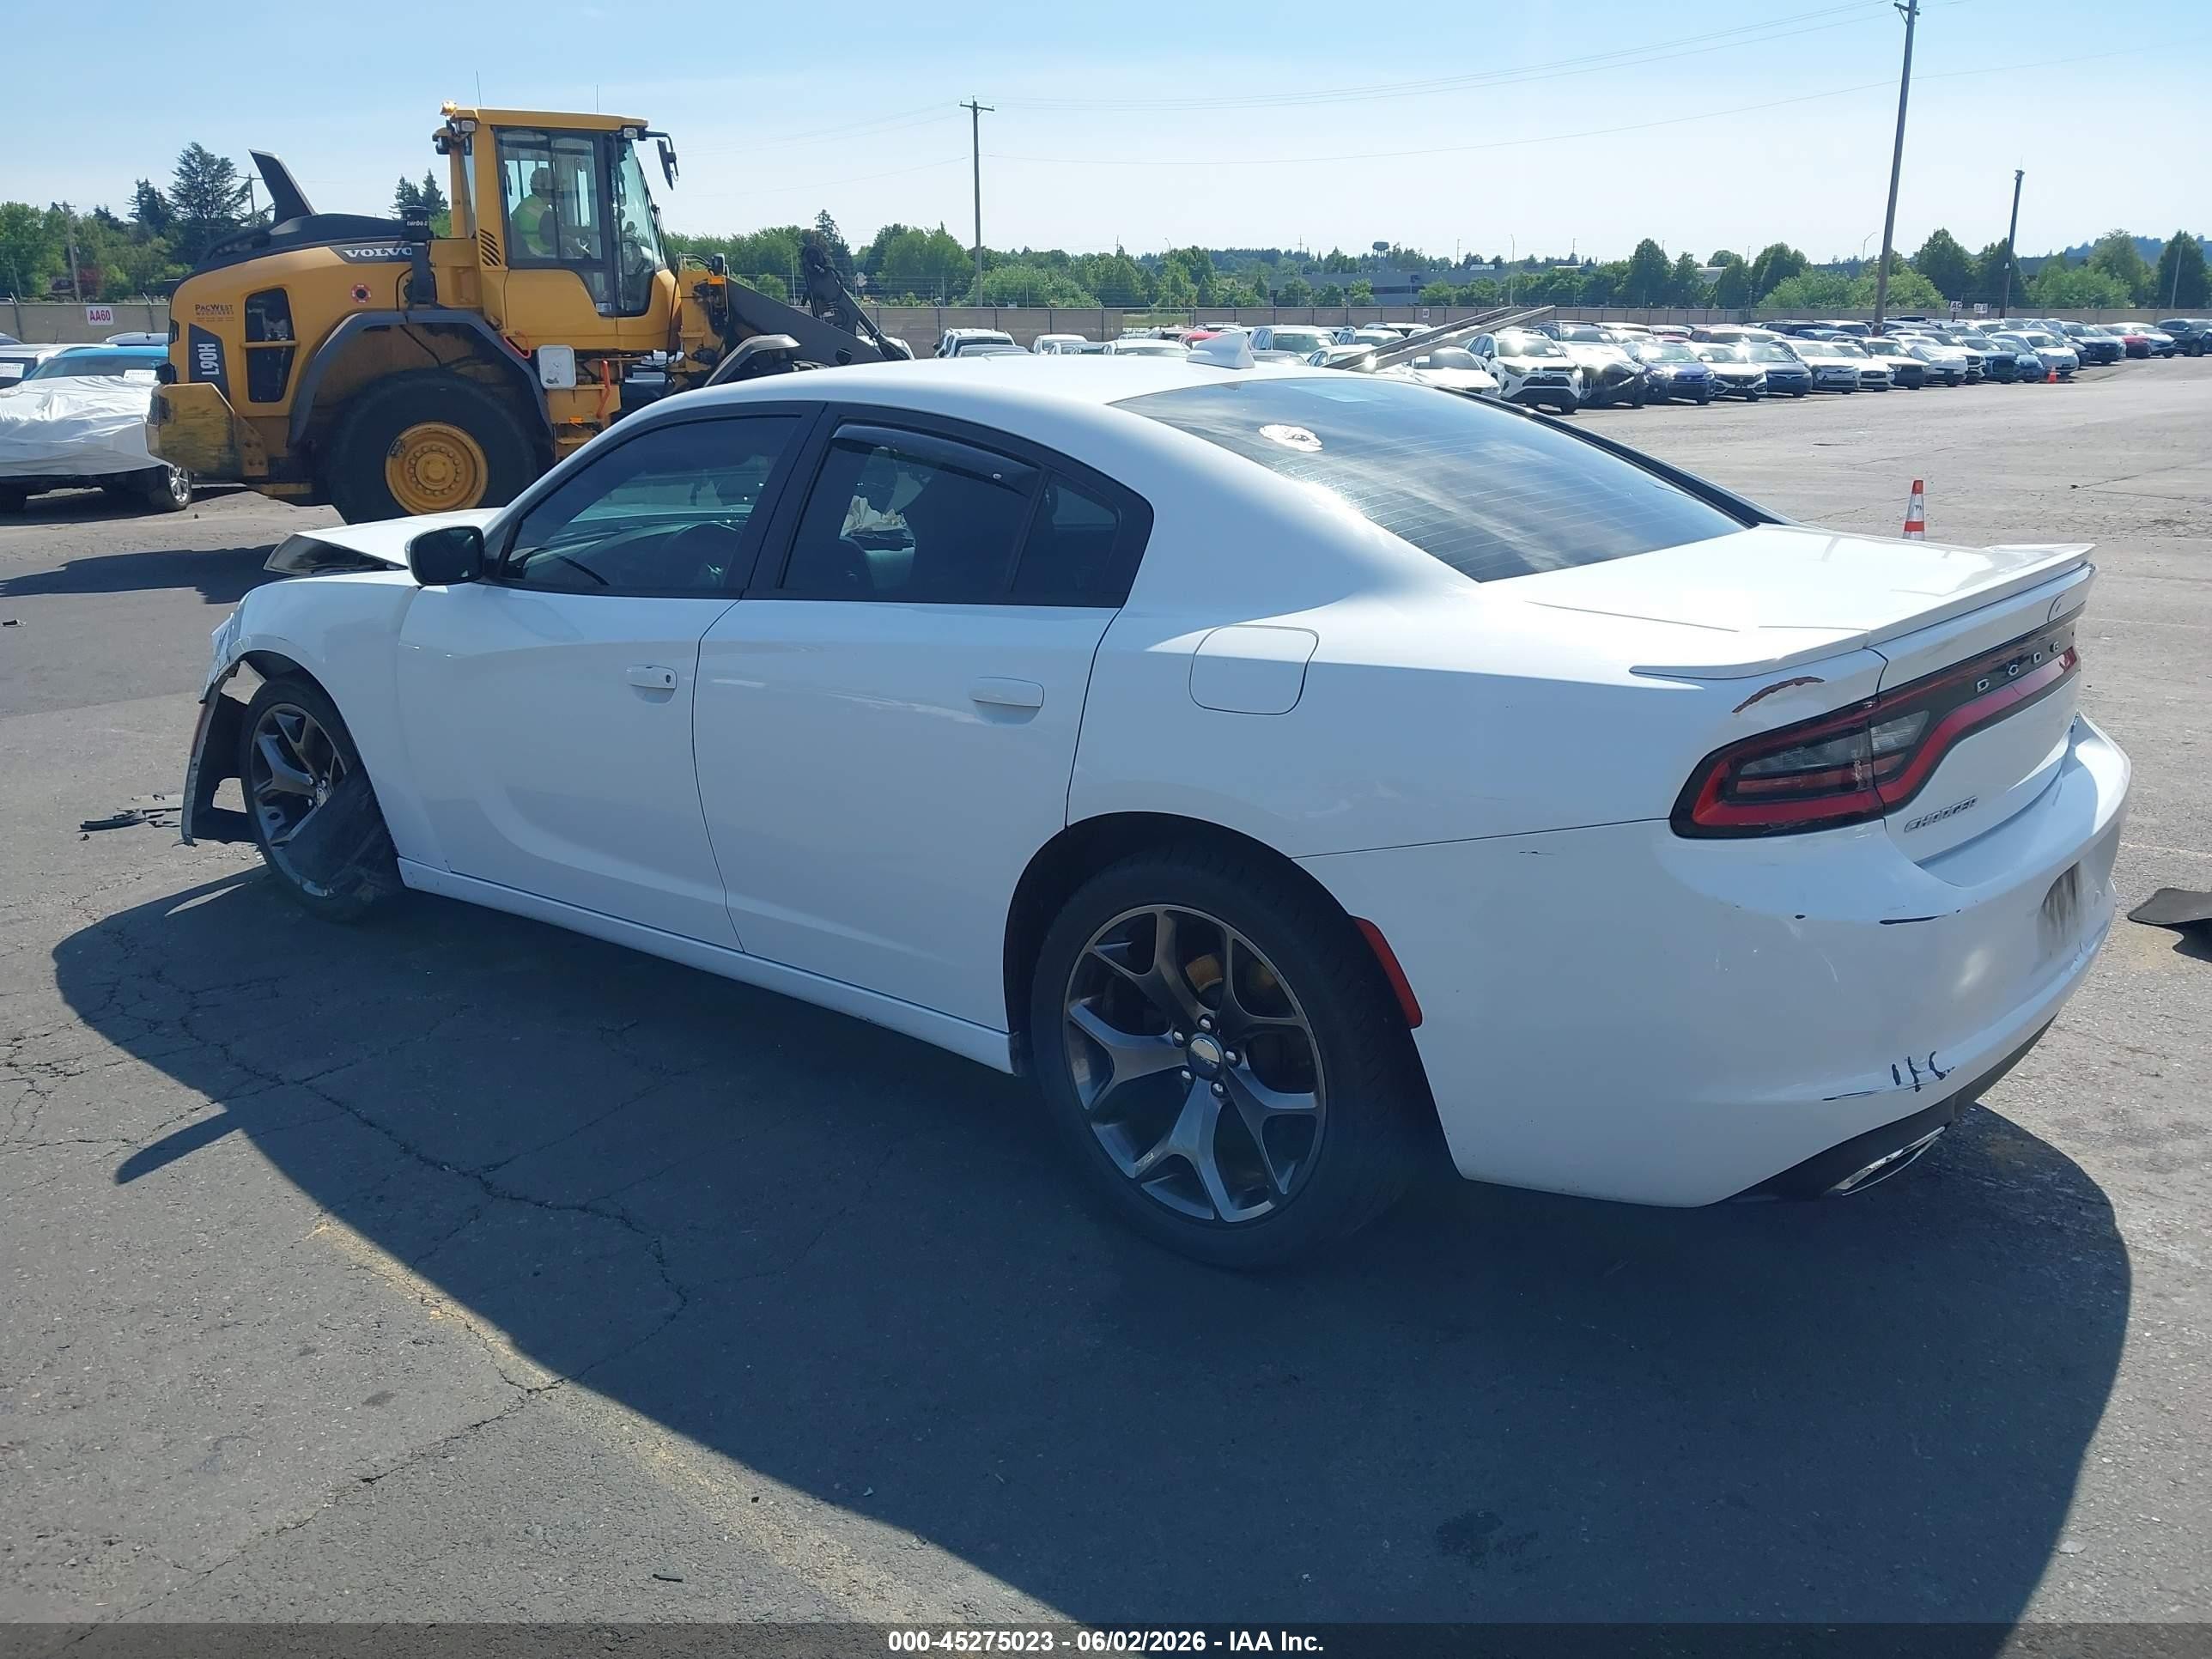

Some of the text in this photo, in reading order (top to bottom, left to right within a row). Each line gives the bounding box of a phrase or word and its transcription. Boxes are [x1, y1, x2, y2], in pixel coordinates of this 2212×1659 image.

[343, 246, 412, 258] VOLVO
[89, 309, 111, 321] AA60
[197, 343, 220, 375] L90H
